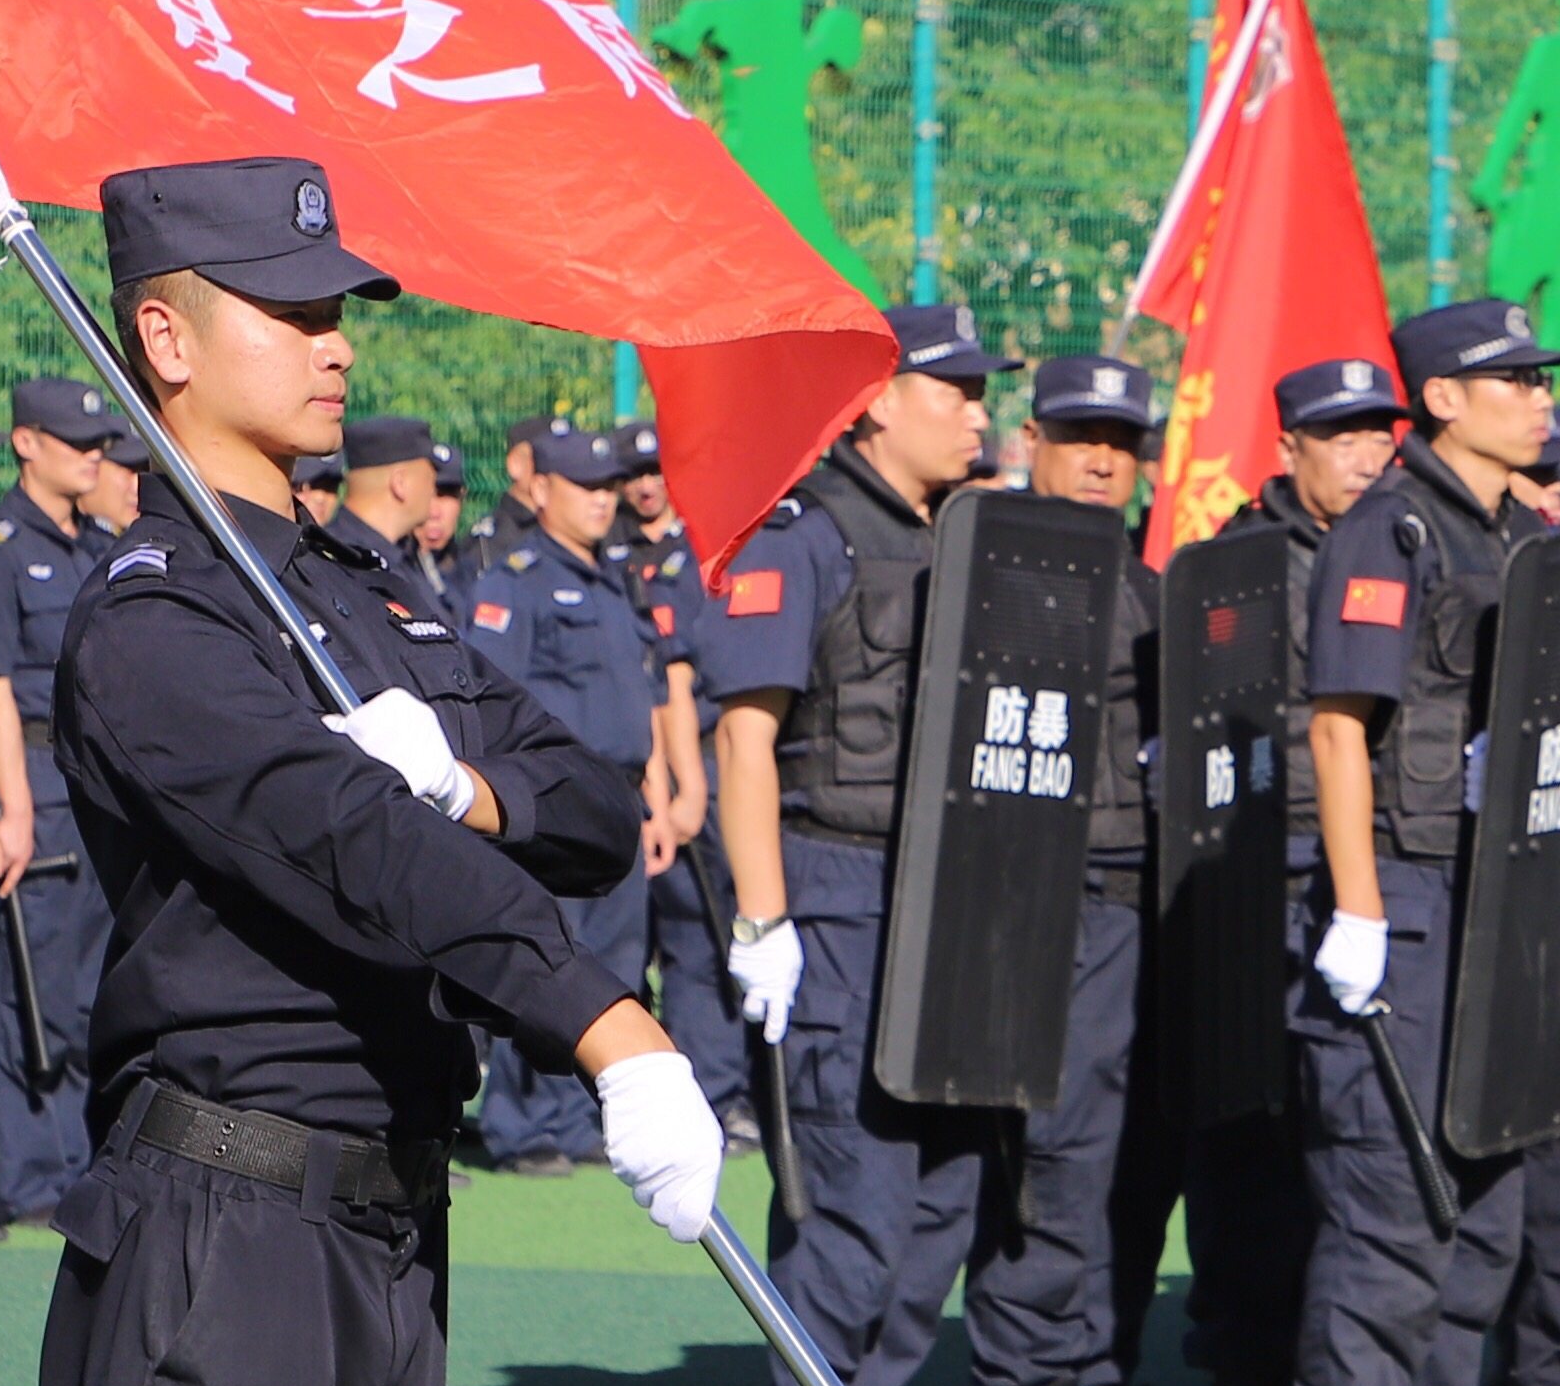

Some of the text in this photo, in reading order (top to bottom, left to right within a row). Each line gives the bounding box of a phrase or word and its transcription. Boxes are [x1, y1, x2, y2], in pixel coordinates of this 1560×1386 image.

[984, 685, 1069, 750] 防暴
[971, 742, 1073, 798] FANG BAO
